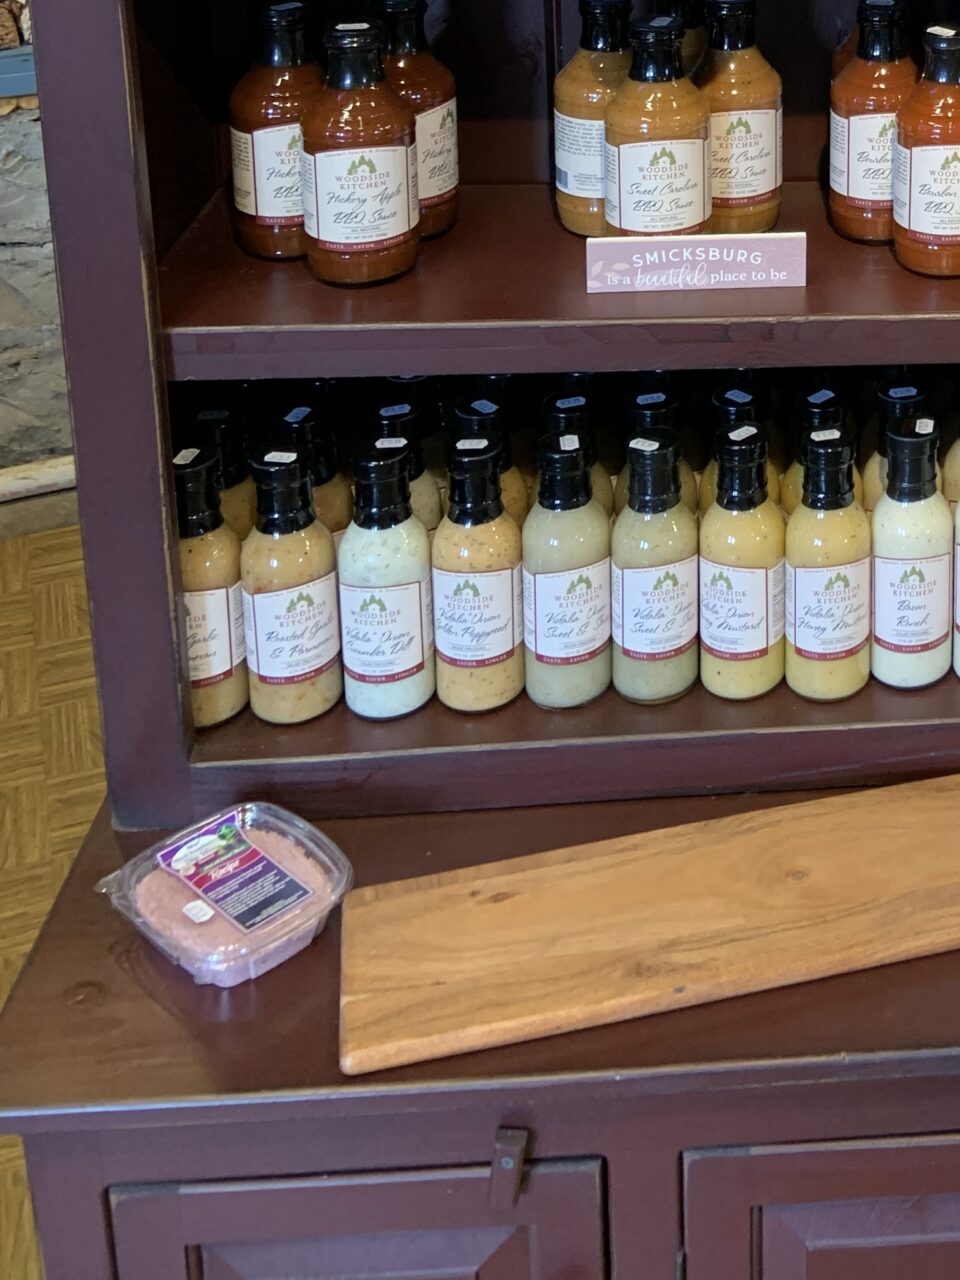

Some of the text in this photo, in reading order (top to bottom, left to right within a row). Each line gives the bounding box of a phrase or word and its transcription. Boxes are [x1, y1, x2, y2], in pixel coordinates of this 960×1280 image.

[715, 133, 763, 142] WOODSIDE
[720, 141, 760, 149] KITCHEN
[638, 163, 689, 173] WOODSIDE
[335, 172, 390, 182] WOODSIDE
[642, 172, 685, 180] KITCHEN
[340, 181, 386, 190] KITCHEN
[627, 183, 656, 195] Sweet
[918, 184, 956, 197] Bourbon
[326, 183, 402, 211] Hickory Apple
[633, 198, 694, 213] BBQ Sauce
[924, 202, 954, 215] BBQ
[333, 206, 397, 225] BBQ Sauce
[633, 248, 762, 267] SMICKSBURG
[608, 263, 787, 288] is a beautiful place to be
[896, 614, 929, 627] Ranch
